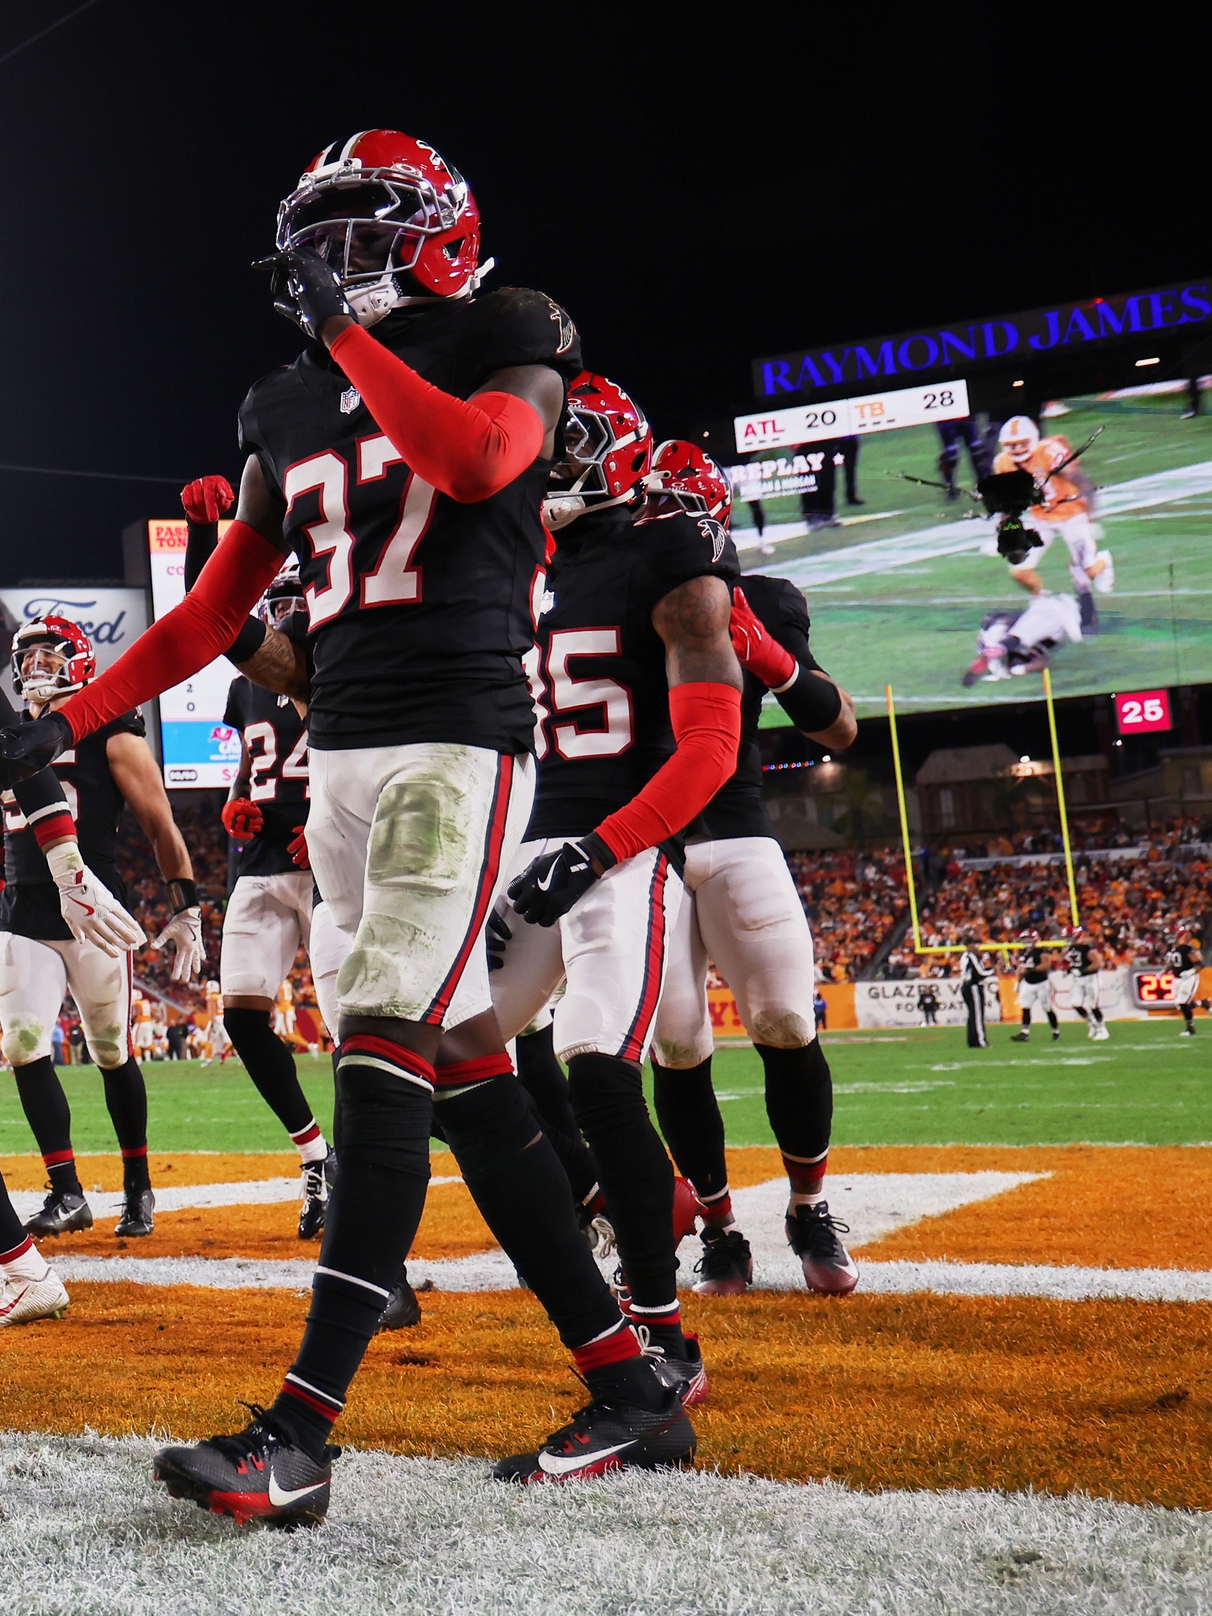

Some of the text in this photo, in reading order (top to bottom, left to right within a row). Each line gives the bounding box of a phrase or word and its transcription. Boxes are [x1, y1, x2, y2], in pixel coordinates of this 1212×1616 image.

[761, 285, 1212, 397] RAYMOND JAMES
[743, 390, 955, 438] ATL 20 TB 28
[730, 452, 826, 483] REPLAY
[283, 431, 437, 635] 37
[1121, 698, 1164, 724] 25
[243, 719, 309, 803] 24
